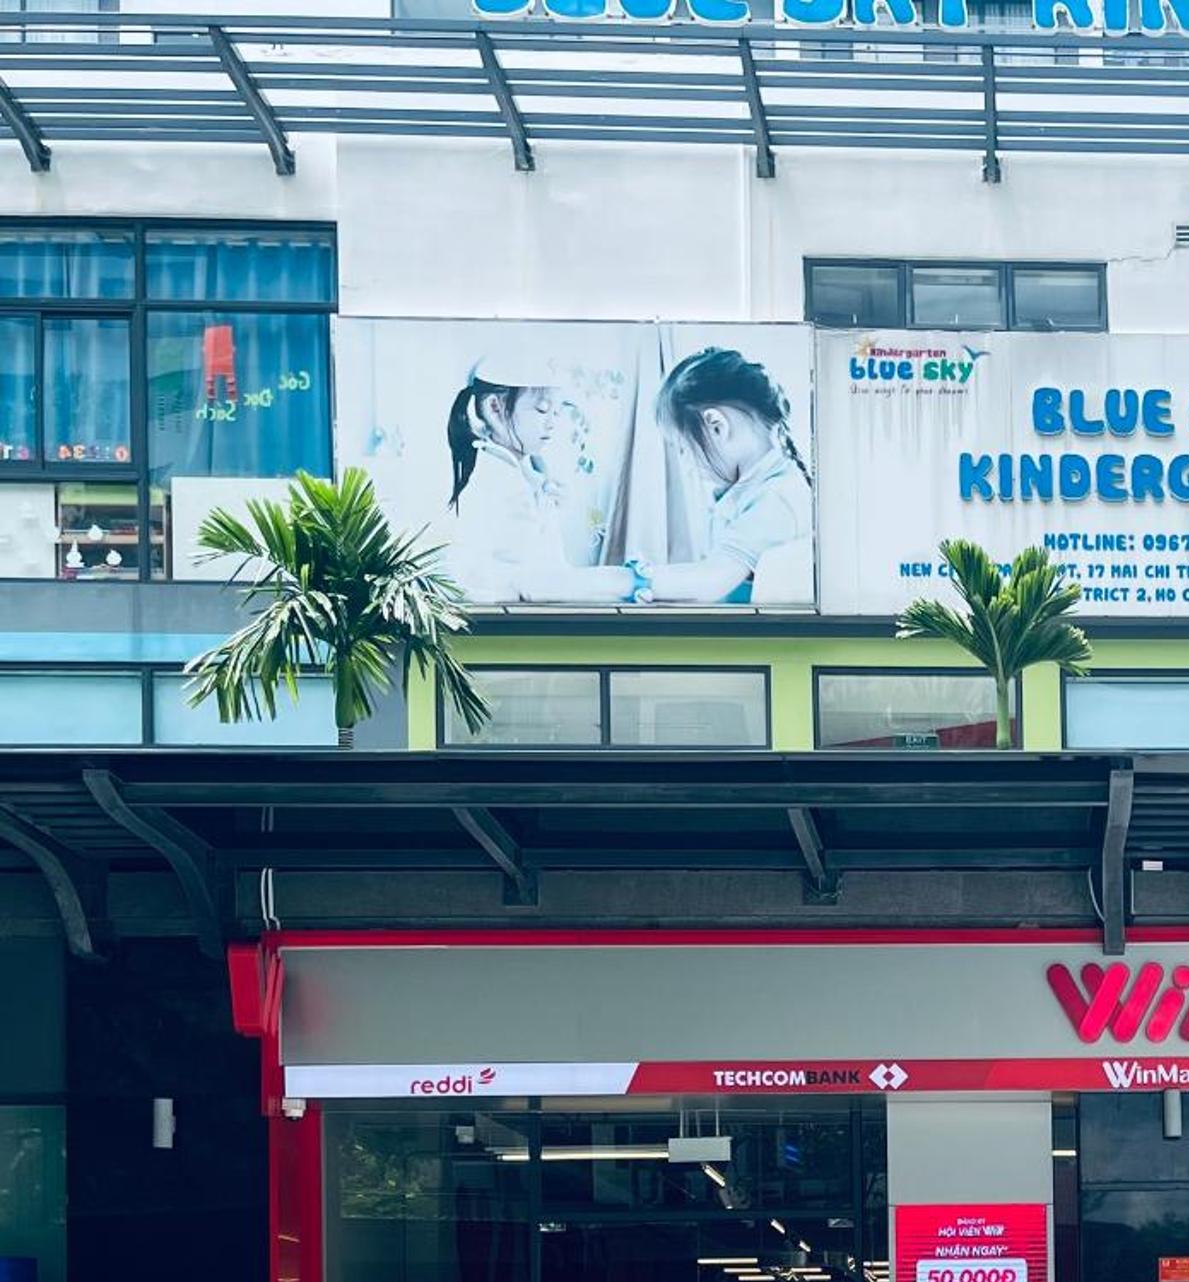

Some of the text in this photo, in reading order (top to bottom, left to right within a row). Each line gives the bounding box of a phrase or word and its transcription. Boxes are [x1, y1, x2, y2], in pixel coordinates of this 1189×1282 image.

[850, 357, 973, 383] blue sky
[1032, 387, 1177, 438] BLUE
[1044, 533, 1134, 551] HOTLINE:
[899, 563, 932, 577] NEW
[1088, 564, 1105, 578] 17
[1111, 564, 1138, 578] MAI
[1145, 565, 1170, 579] CHI
[1083, 587, 1129, 602] TRICT
[1155, 588, 1176, 602] HO
[410, 1075, 473, 1095] reddi
[713, 1070, 860, 1087] TECHCOMBANK
